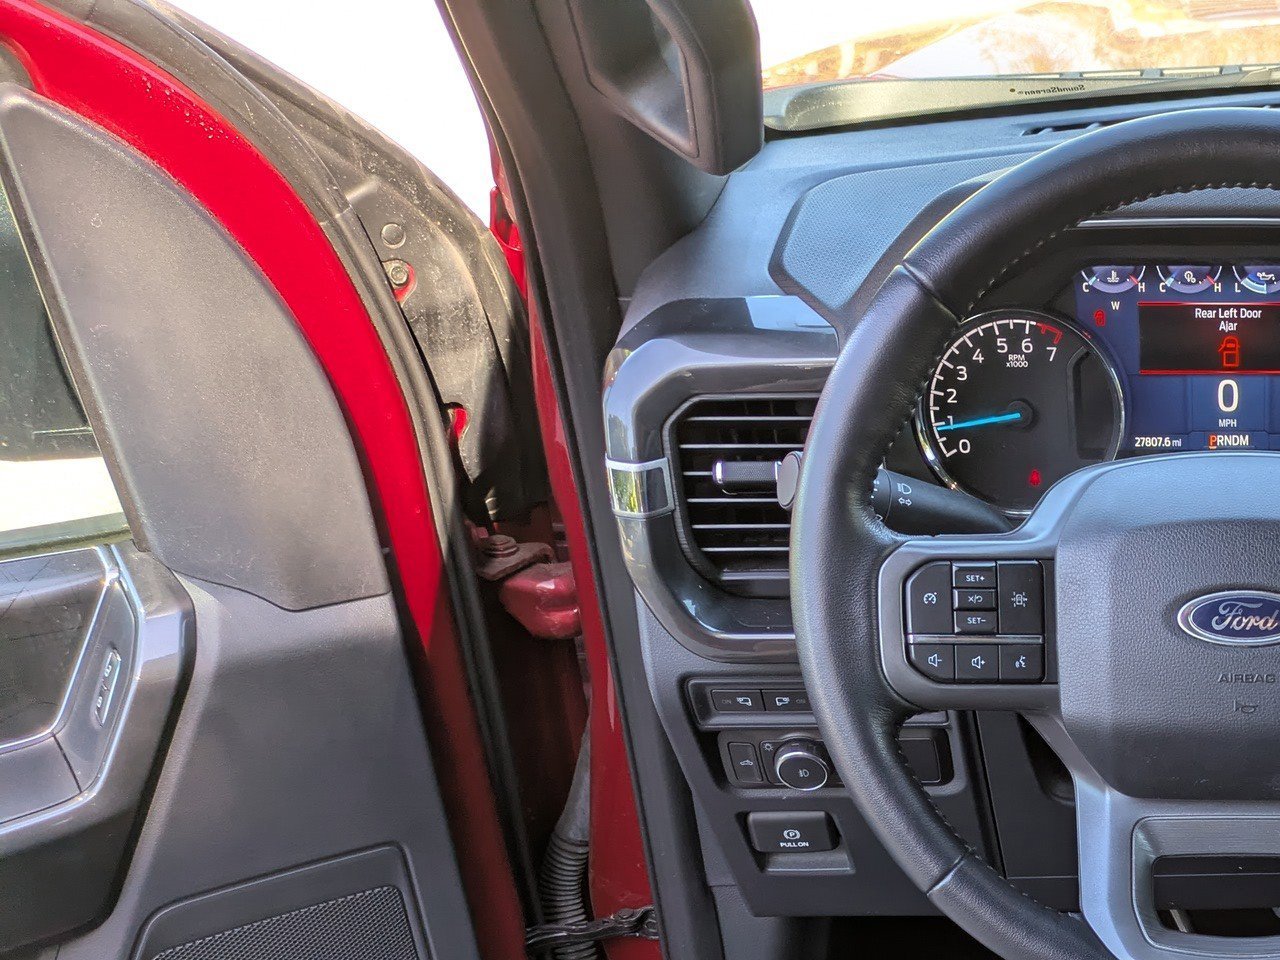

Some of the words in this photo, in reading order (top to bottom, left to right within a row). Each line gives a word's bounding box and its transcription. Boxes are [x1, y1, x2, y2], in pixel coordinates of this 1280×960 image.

[1082, 282, 1090, 293] C
[1138, 282, 1146, 293] H
[1159, 282, 1167, 293] C
[1214, 282, 1222, 293] H
[1235, 282, 1242, 293] L
[1111, 301, 1121, 311] W
[1194, 308, 1216, 319] Rear
[1218, 307, 1238, 319] Left
[1239, 308, 1262, 319] Door
[1218, 320, 1238, 333] Ajar
[997, 338, 1008, 353] 5
[1021, 338, 1033, 353] 6
[972, 348, 985, 364] 4
[1046, 346, 1057, 362] 7
[956, 365, 968, 381] 3
[946, 388, 957, 403] 2
[1217, 379, 1239, 412] 0
[1218, 418, 1237, 428] MPH
[959, 438, 971, 454] 0
[1134, 437, 1170, 447] 27807.6
[1172, 438, 1182, 447] mi
[966, 574, 985, 582] SET+
[1211, 601, 1280, 631] Ford
[1218, 673, 1277, 684] AIRBAG
